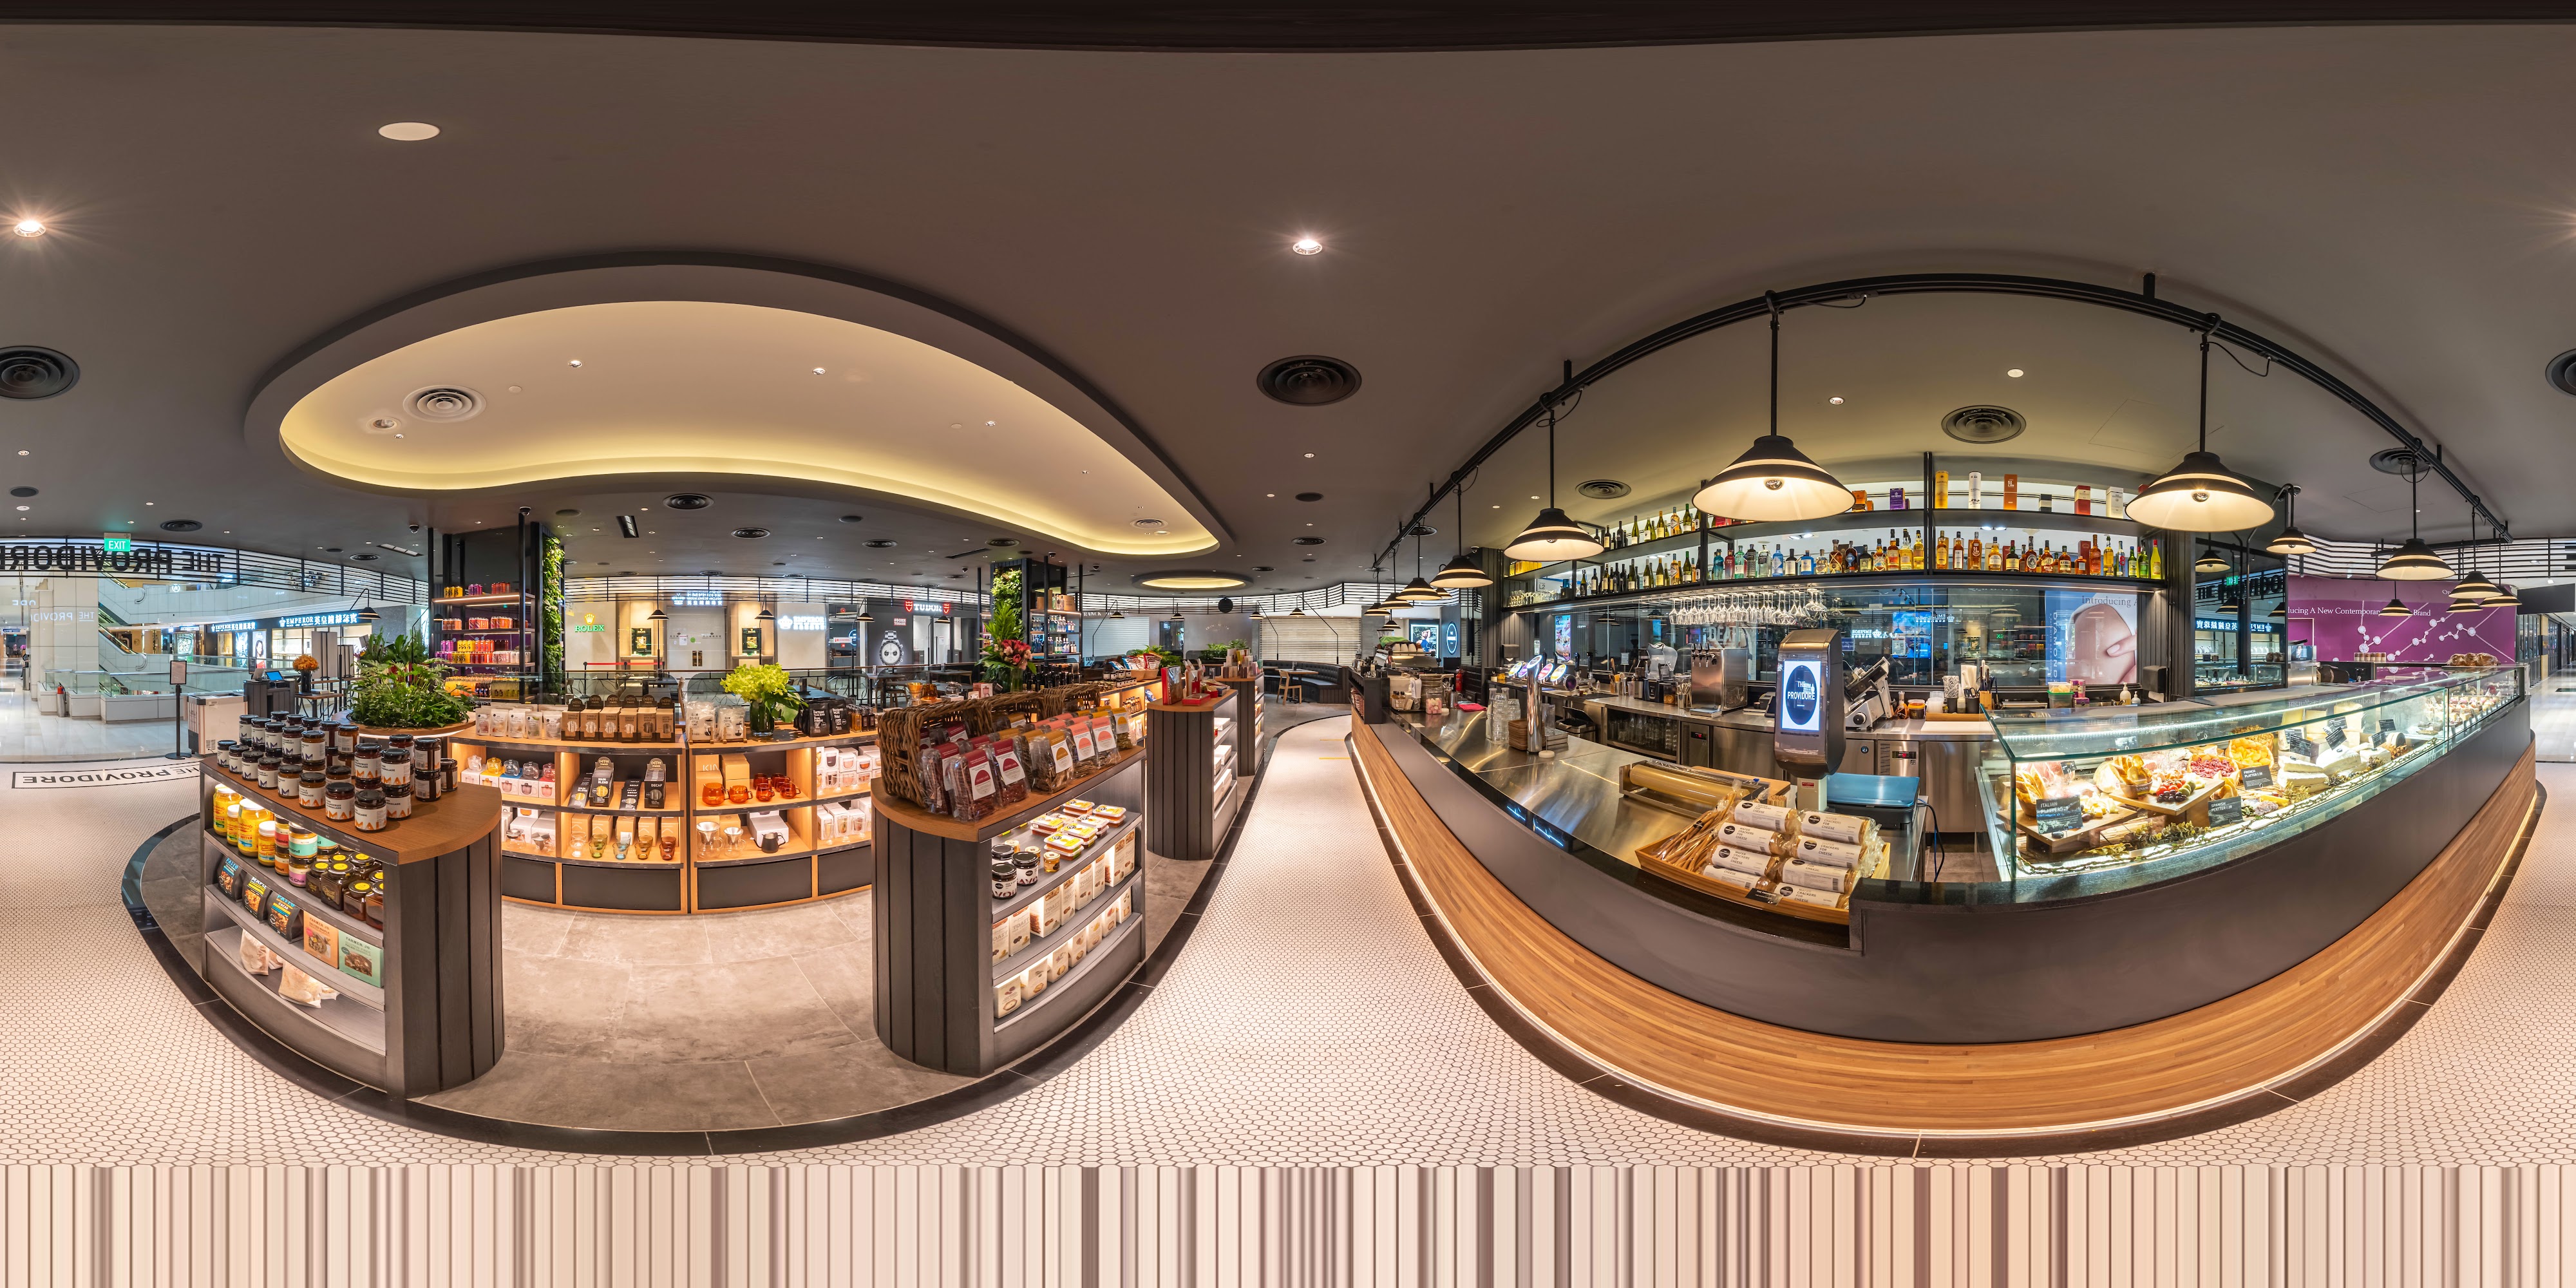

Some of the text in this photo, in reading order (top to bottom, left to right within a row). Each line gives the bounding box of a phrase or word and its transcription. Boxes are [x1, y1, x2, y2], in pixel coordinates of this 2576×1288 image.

[108, 540, 126, 550] EXIT
[2081, 595, 2130, 608] Introducing
[913, 603, 942, 612] TUDOR
[2335, 607, 2380, 616] Contemporar
[286, 616, 314, 625] EMPEROR
[1788, 692, 1815, 700] PROVIDORE
[225, 858, 238, 869] PALEO
[277, 895, 295, 907] PALEO
[1046, 902, 1059, 912] TOAST
[309, 917, 323, 927] FARMER
[1012, 919, 1029, 929] TOAST
[994, 931, 1007, 940] OAST
[346, 937, 363, 947] FARMER
